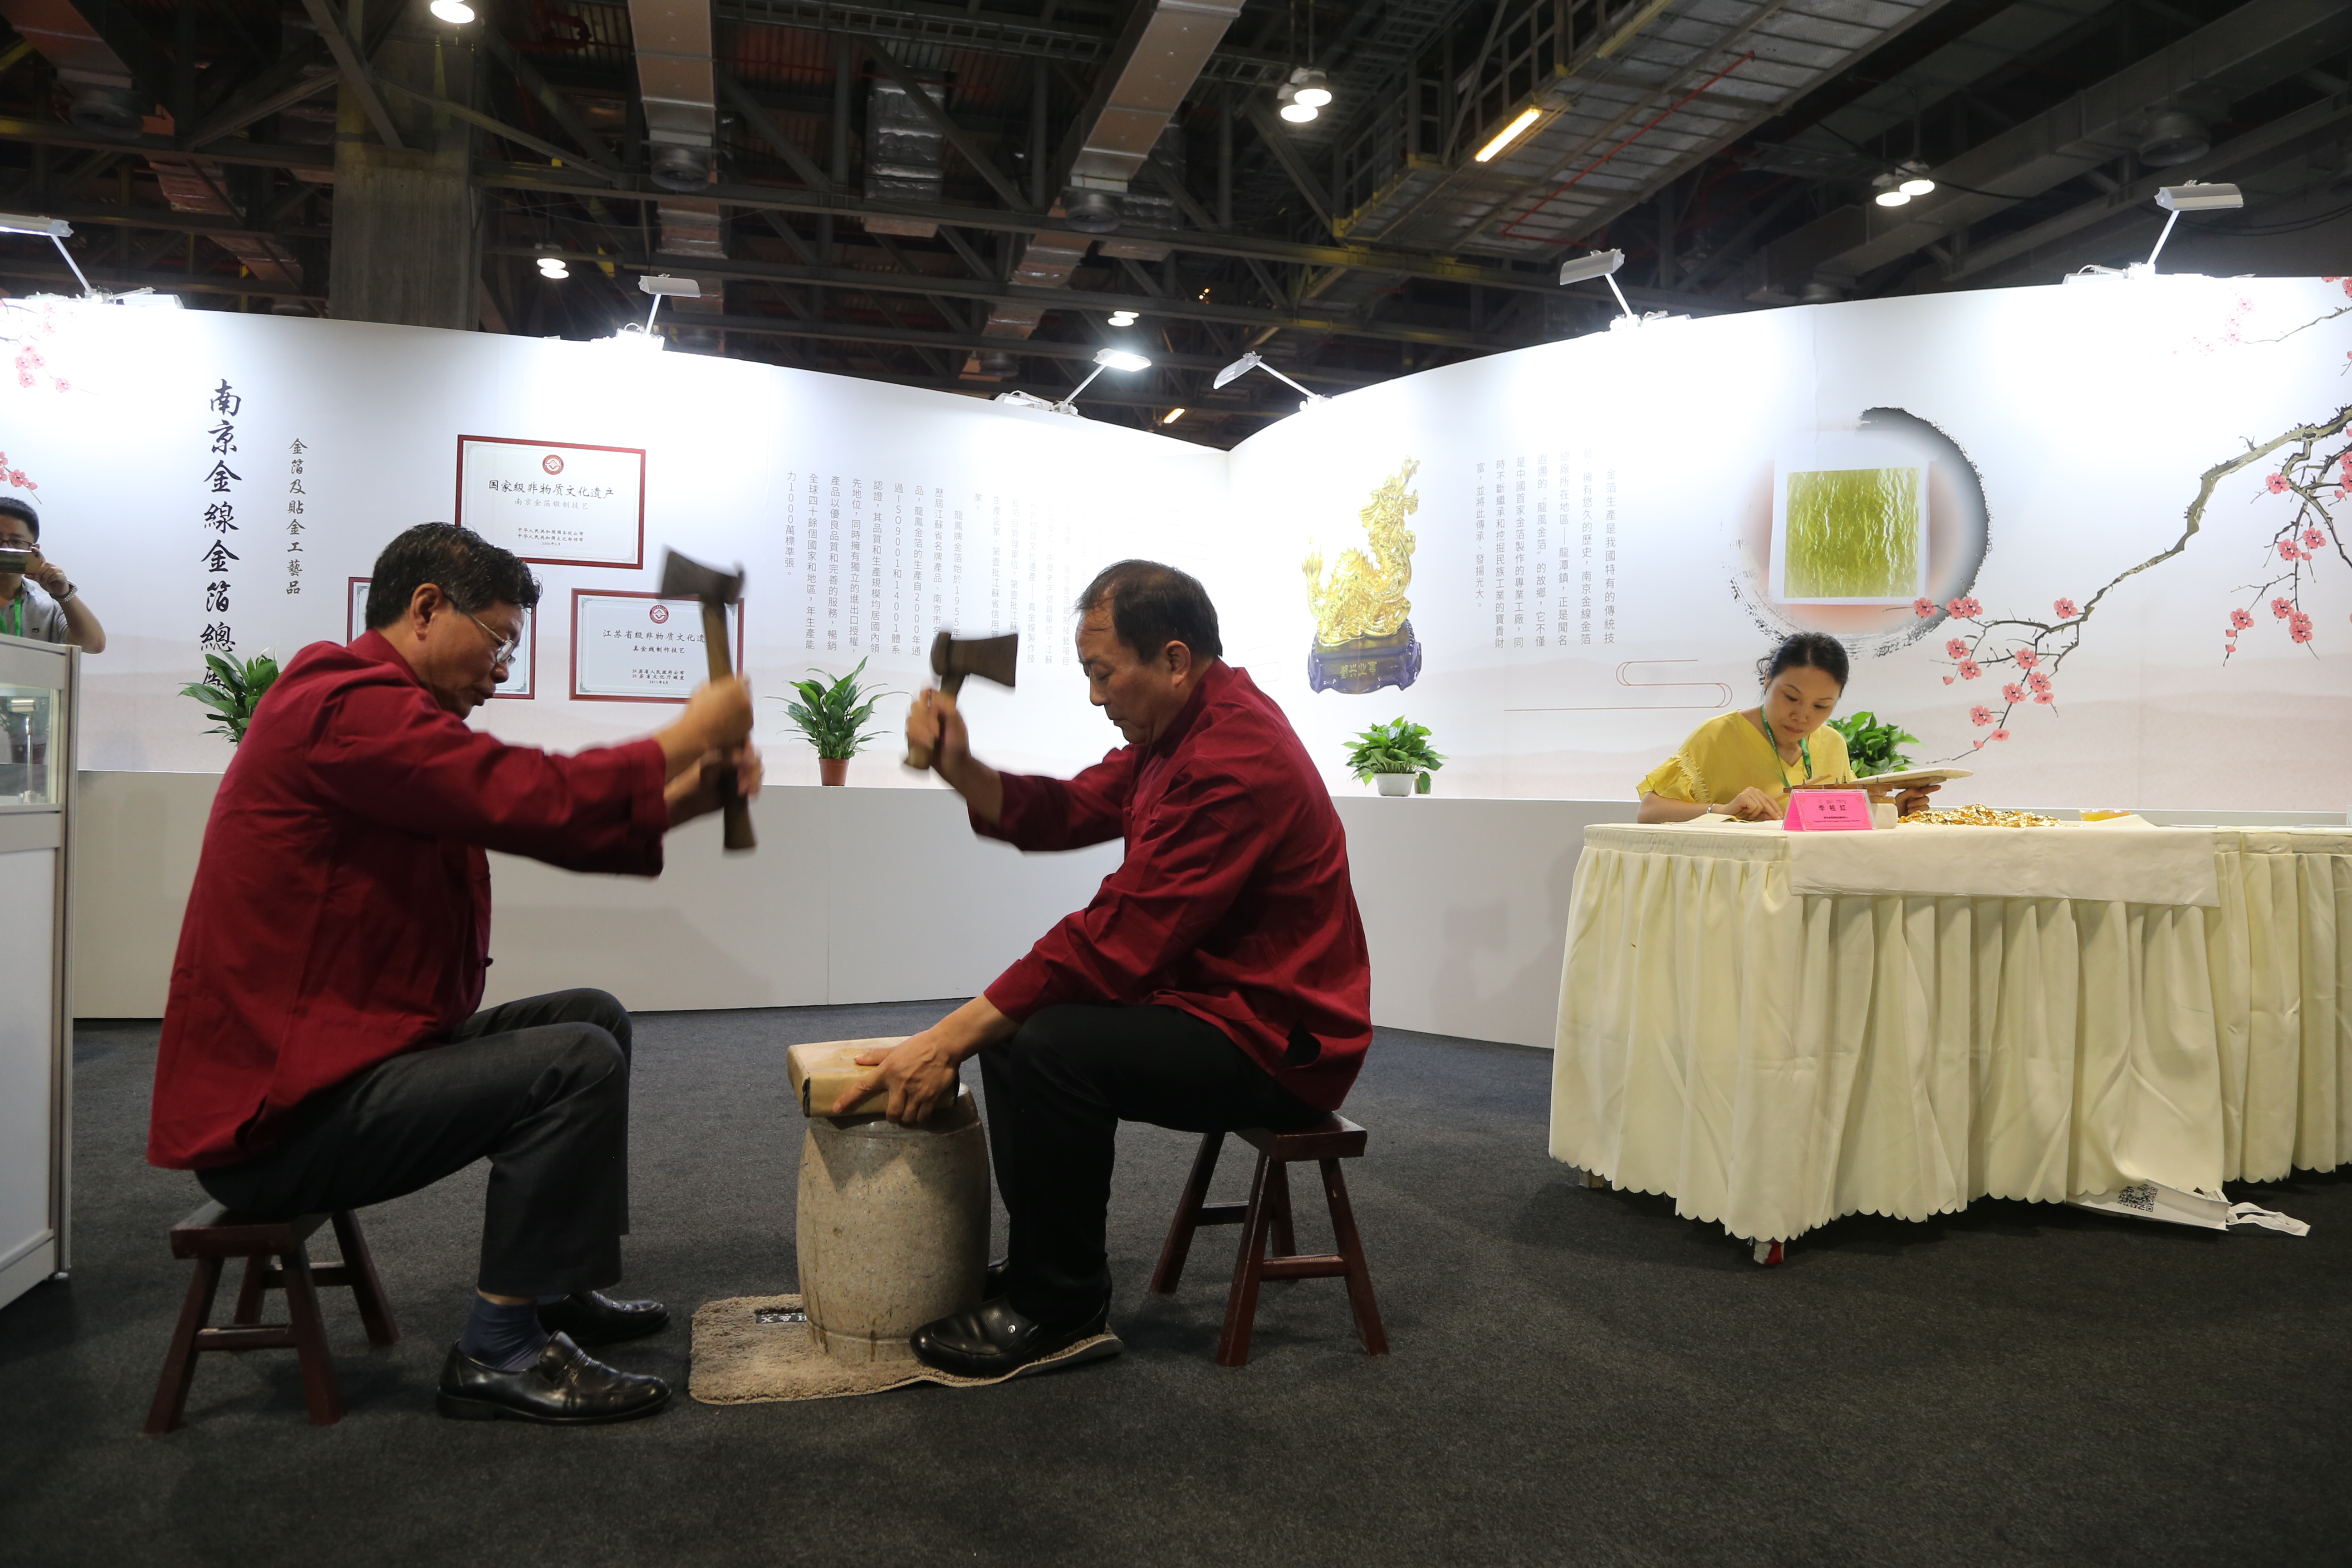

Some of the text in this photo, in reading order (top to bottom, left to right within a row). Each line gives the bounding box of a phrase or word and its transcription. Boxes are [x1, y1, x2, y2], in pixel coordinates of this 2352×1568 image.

[286, 438, 308, 594] 金箔及貼金工藝品
[489, 480, 614, 499] 国家级非物质文化遗产
[785, 471, 796, 575] 力1000萬標準張。
[933, 488, 944, 636] 歷屆江蘇省名牌產品、南京市名
[1604, 469, 1616, 644] 金箔生產是我國特有的傳統技
